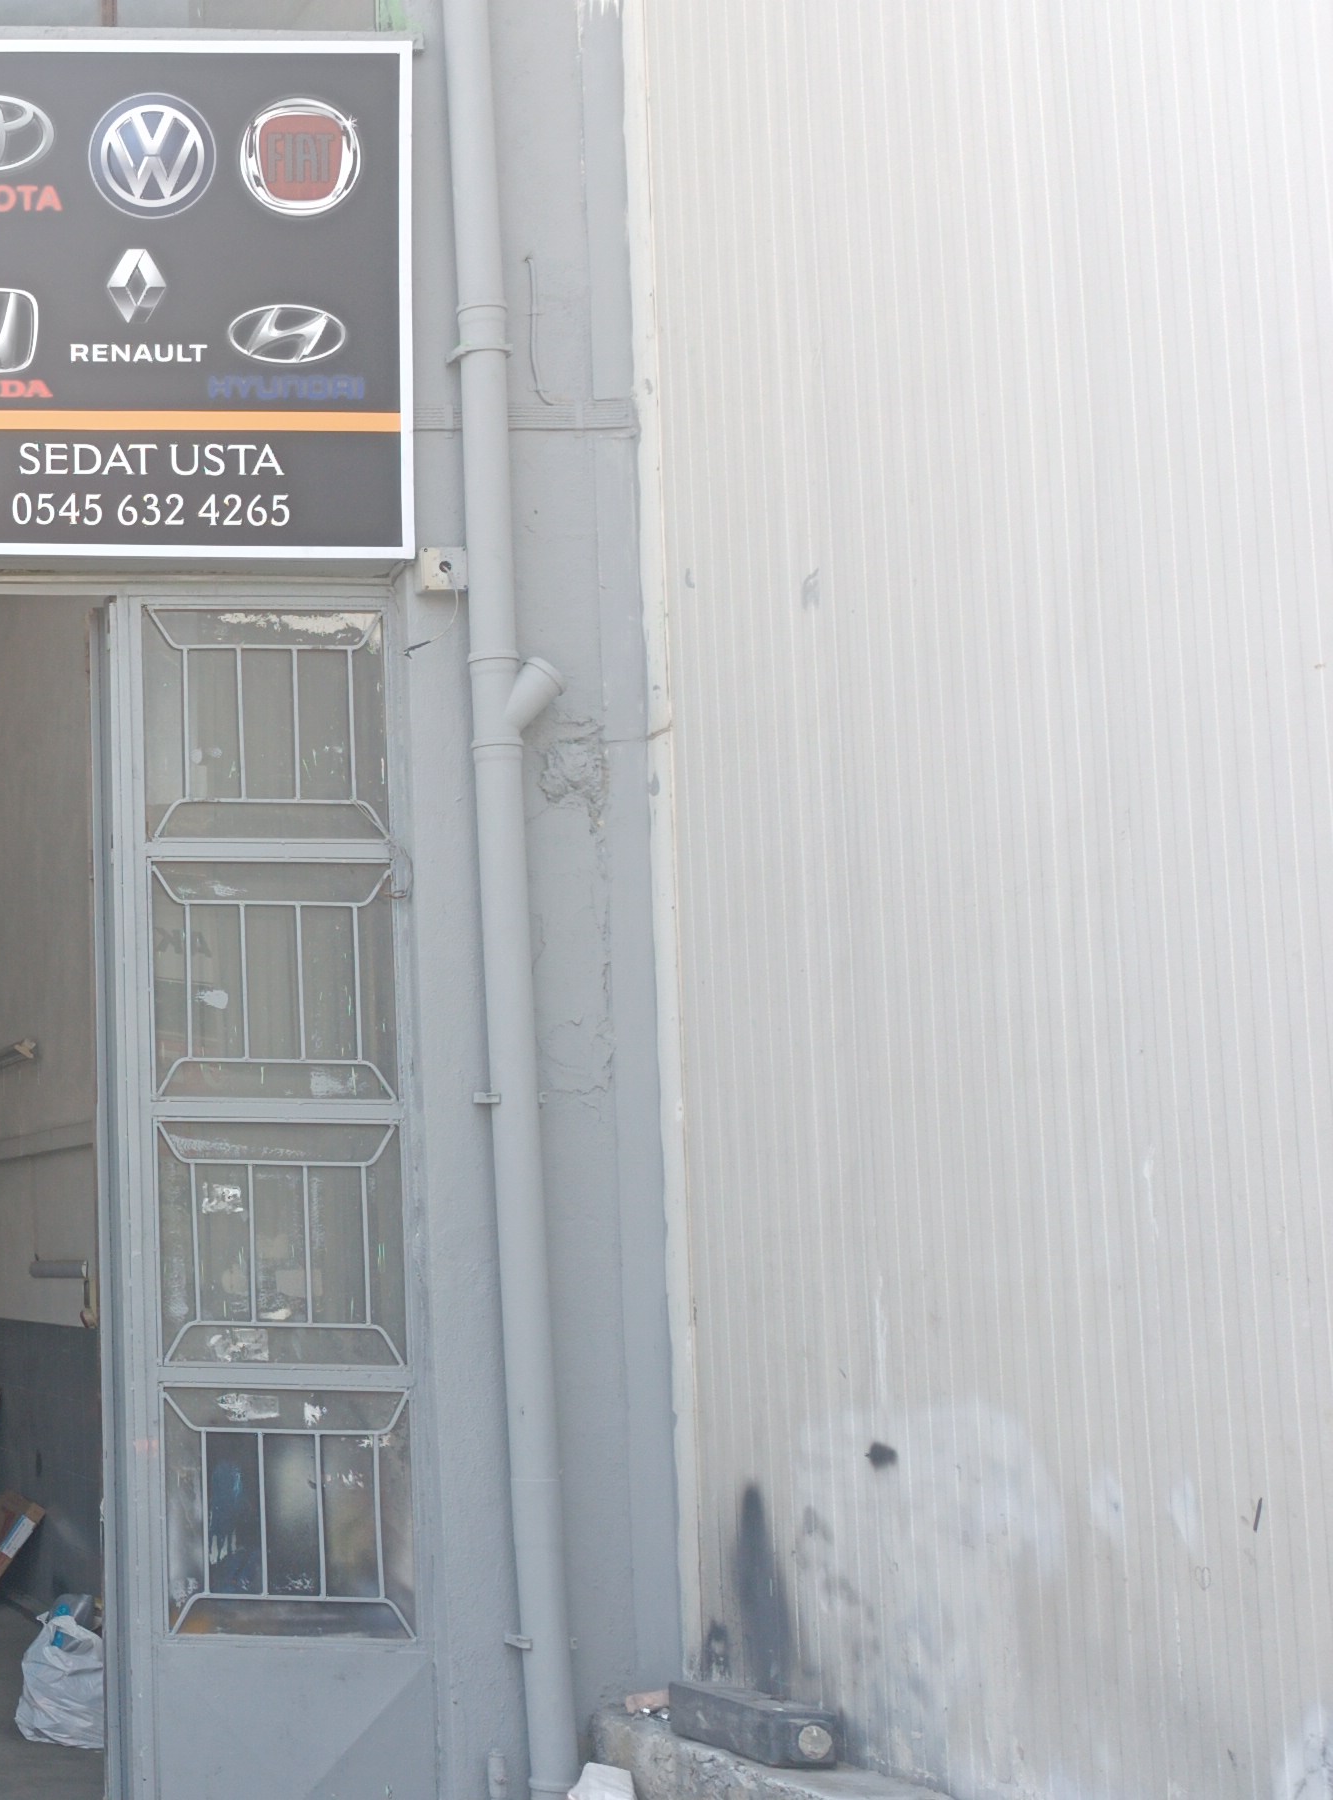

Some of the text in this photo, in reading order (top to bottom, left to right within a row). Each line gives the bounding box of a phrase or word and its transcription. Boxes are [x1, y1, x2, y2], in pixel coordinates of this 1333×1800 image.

[266, 132, 333, 184] FIAT
[70, 343, 208, 363] RENAULT
[208, 375, 365, 400] HYUNDAI
[18, 442, 285, 476] SEDAT USTA
[12, 492, 291, 526] 0545 632 4265
